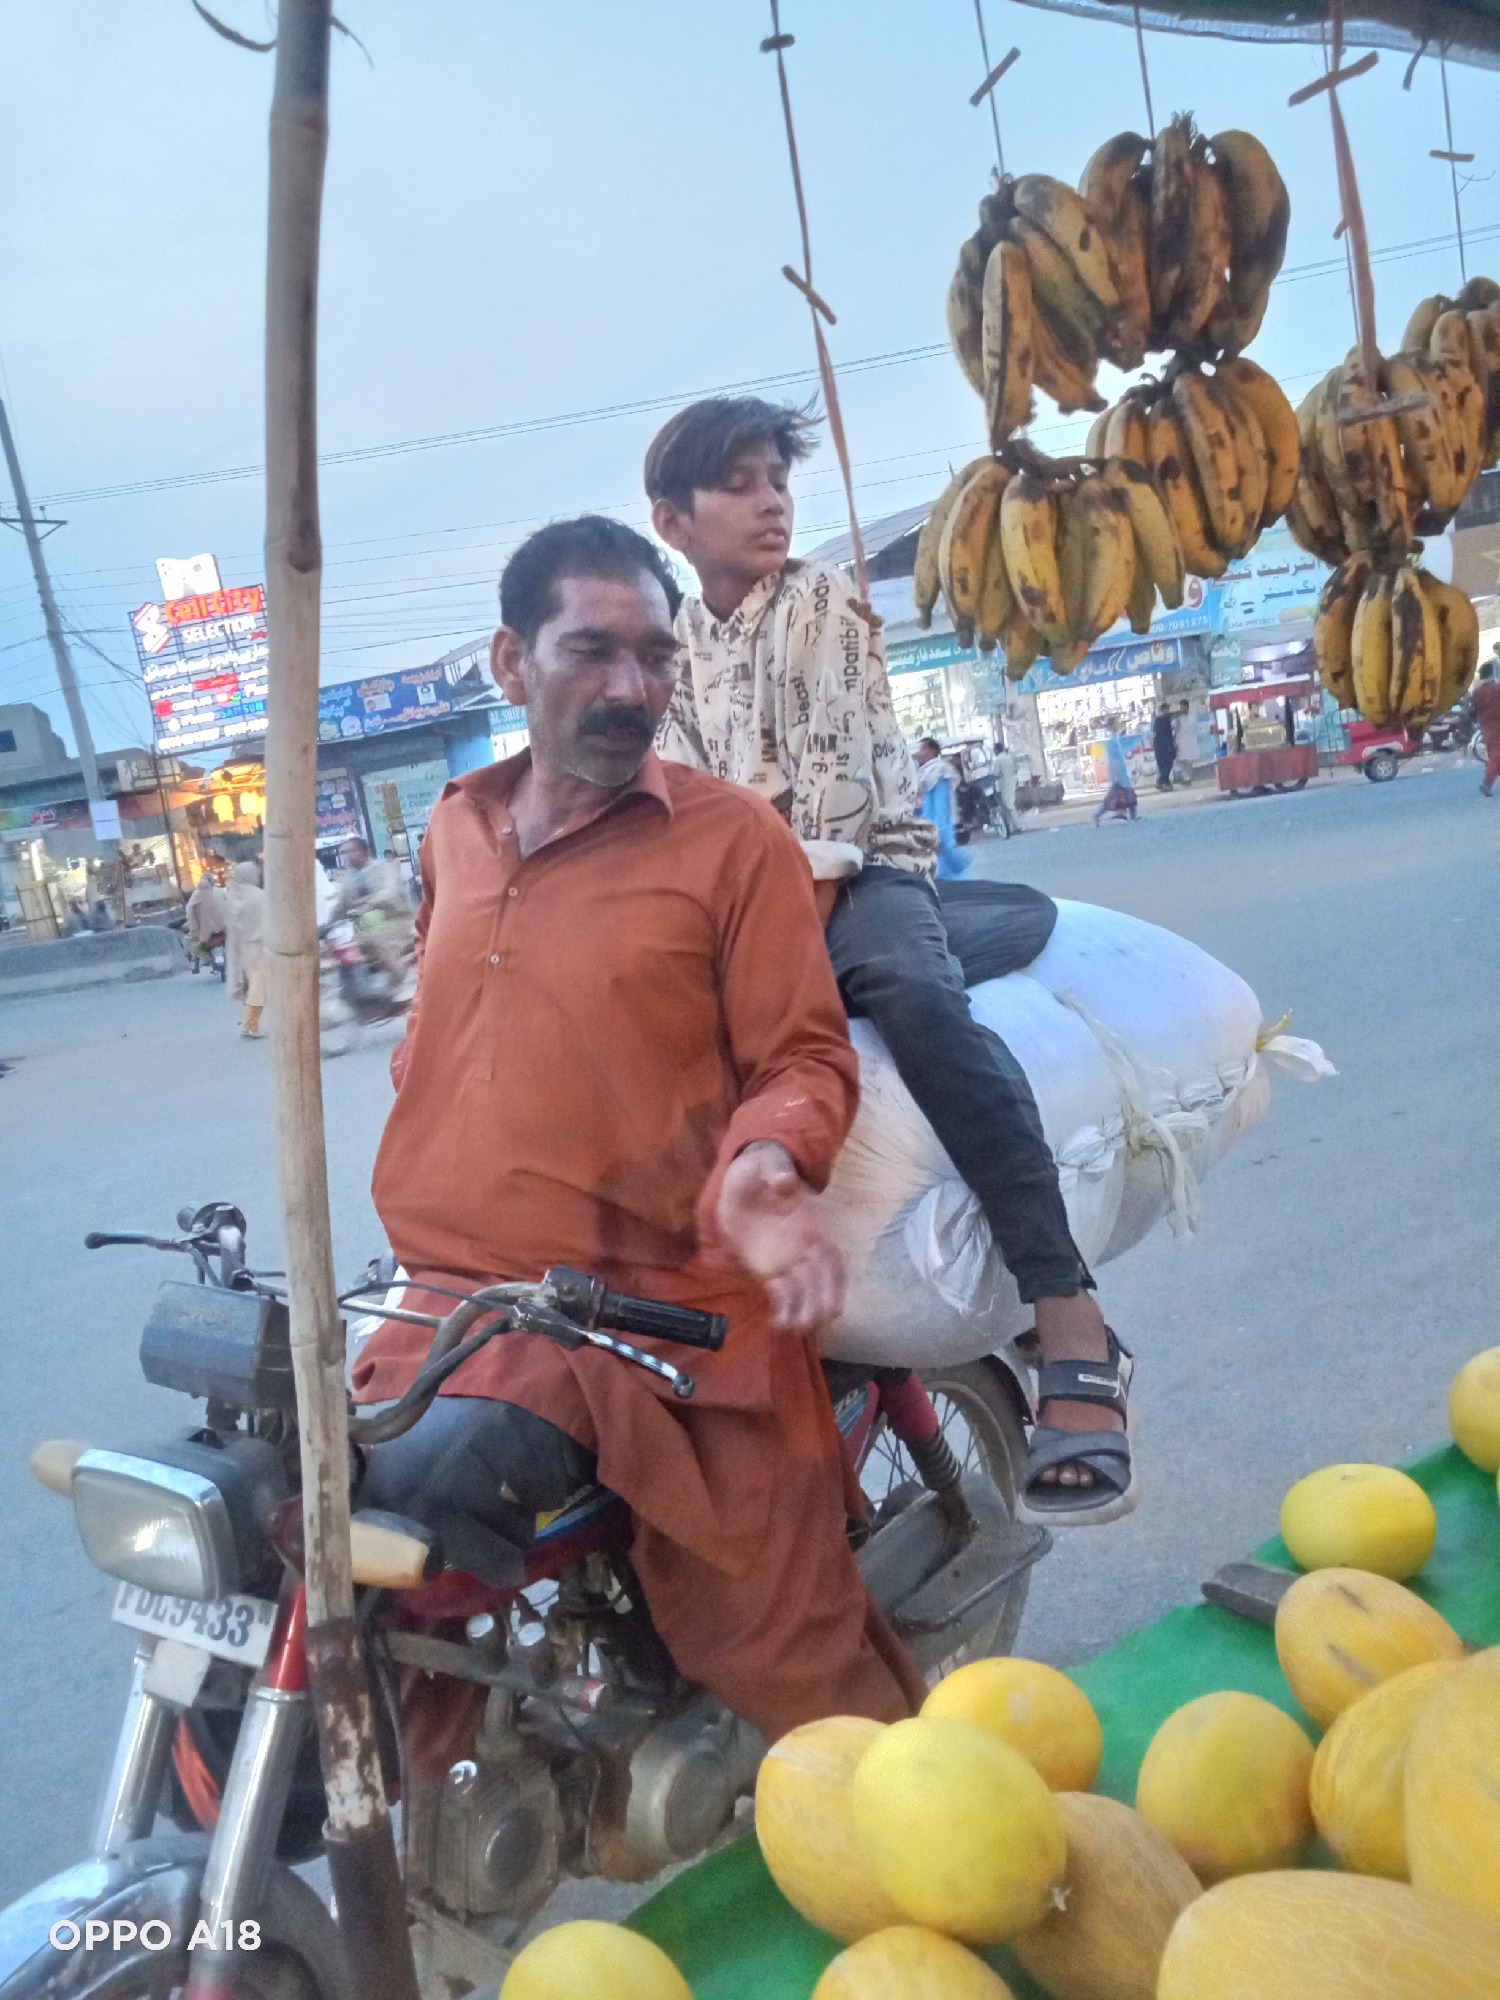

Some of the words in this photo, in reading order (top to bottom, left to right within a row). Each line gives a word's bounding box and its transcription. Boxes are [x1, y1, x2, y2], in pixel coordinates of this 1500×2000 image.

[164, 595, 212, 626] Cell
[211, 586, 263, 615] City
[182, 615, 256, 644] SELECTION
[221, 700, 266, 719] SAMSUN
